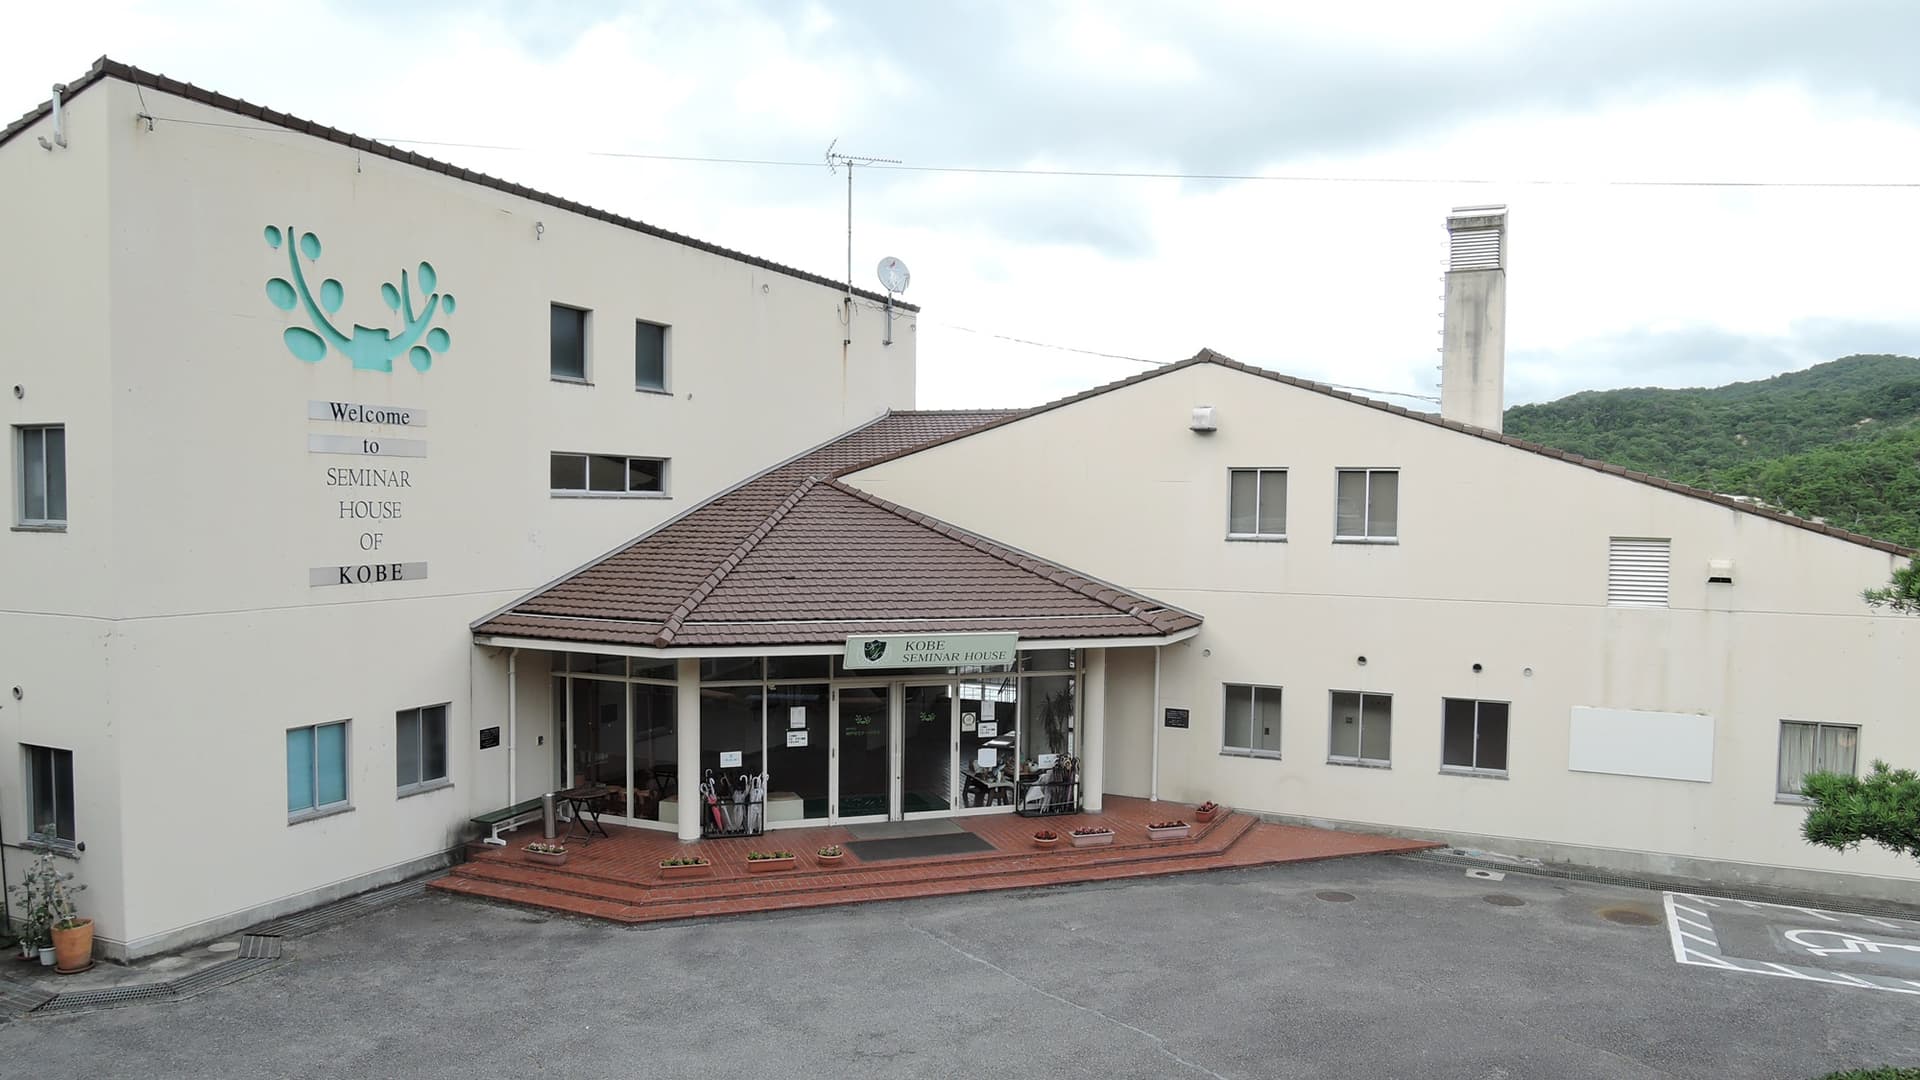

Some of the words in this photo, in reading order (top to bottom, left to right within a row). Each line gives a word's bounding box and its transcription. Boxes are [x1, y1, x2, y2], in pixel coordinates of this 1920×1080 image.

[330, 402, 410, 425] Welcome
[363, 439, 379, 454] to
[326, 467, 412, 488] SEMINAR
[339, 500, 402, 519] HOUSE
[359, 532, 383, 551] OF
[339, 563, 403, 585] KOBE
[905, 640, 945, 651] KOBE
[903, 653, 960, 663] SEMINAR
[965, 651, 1006, 661] HOUSE
